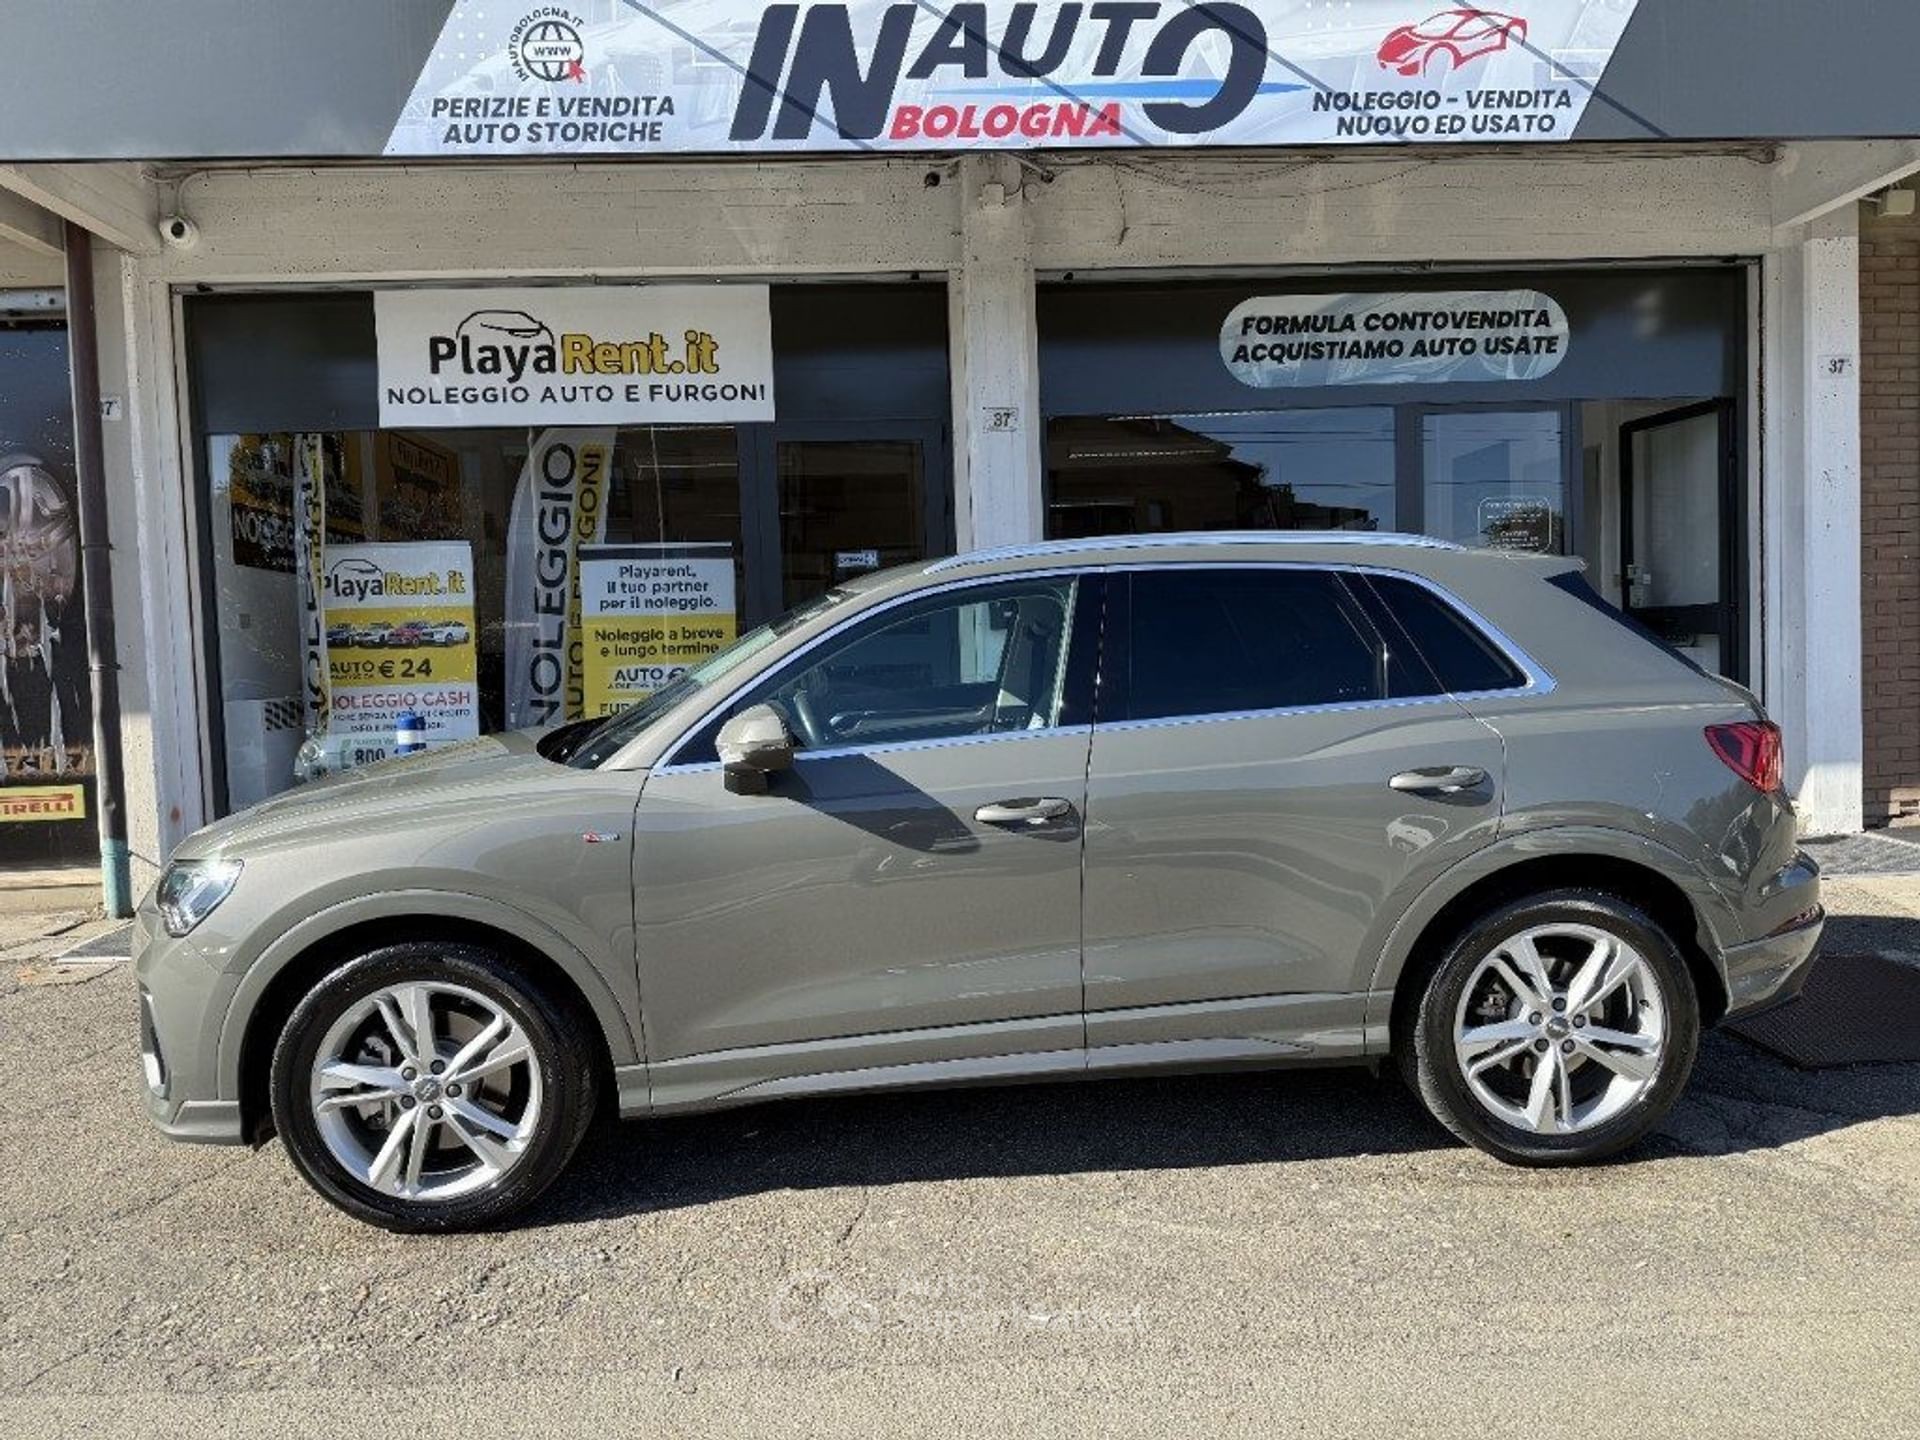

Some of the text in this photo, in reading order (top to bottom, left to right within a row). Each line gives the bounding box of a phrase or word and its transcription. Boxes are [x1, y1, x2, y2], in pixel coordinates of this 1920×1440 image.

[508, 8, 584, 81] INAUTOBOLOGNA.IT
[432, 96, 674, 118] PERIZIE E VENDITA
[1313, 91, 1441, 112] NOLEGGIO
[1467, 90, 1572, 110] VENDITA
[444, 122, 662, 143] AUTO STORICHE
[890, 103, 1124, 140] BOLOGNA
[1336, 114, 1556, 136] NUOVO ED USATO
[1242, 309, 1551, 336] FORMULA CONTOVENDITA
[429, 330, 720, 383] PlayaRent.it
[1231, 335, 1560, 365] ACQUISTIAMO AUTO USATE
[387, 384, 766, 406] NOLEGGIO AUTO E FURGONI
[620, 582, 647, 594] tuo
[652, 580, 709, 596] partner
[600, 598, 625, 611] per
[595, 629, 664, 644] Noleggio
[682, 627, 725, 640] breve
[614, 645, 657, 659] lungo
[662, 642, 720, 655] termine
[614, 668, 664, 682] AUTO
[422, 691, 471, 706] CASH
[0, 801, 74, 816] IRELLI
